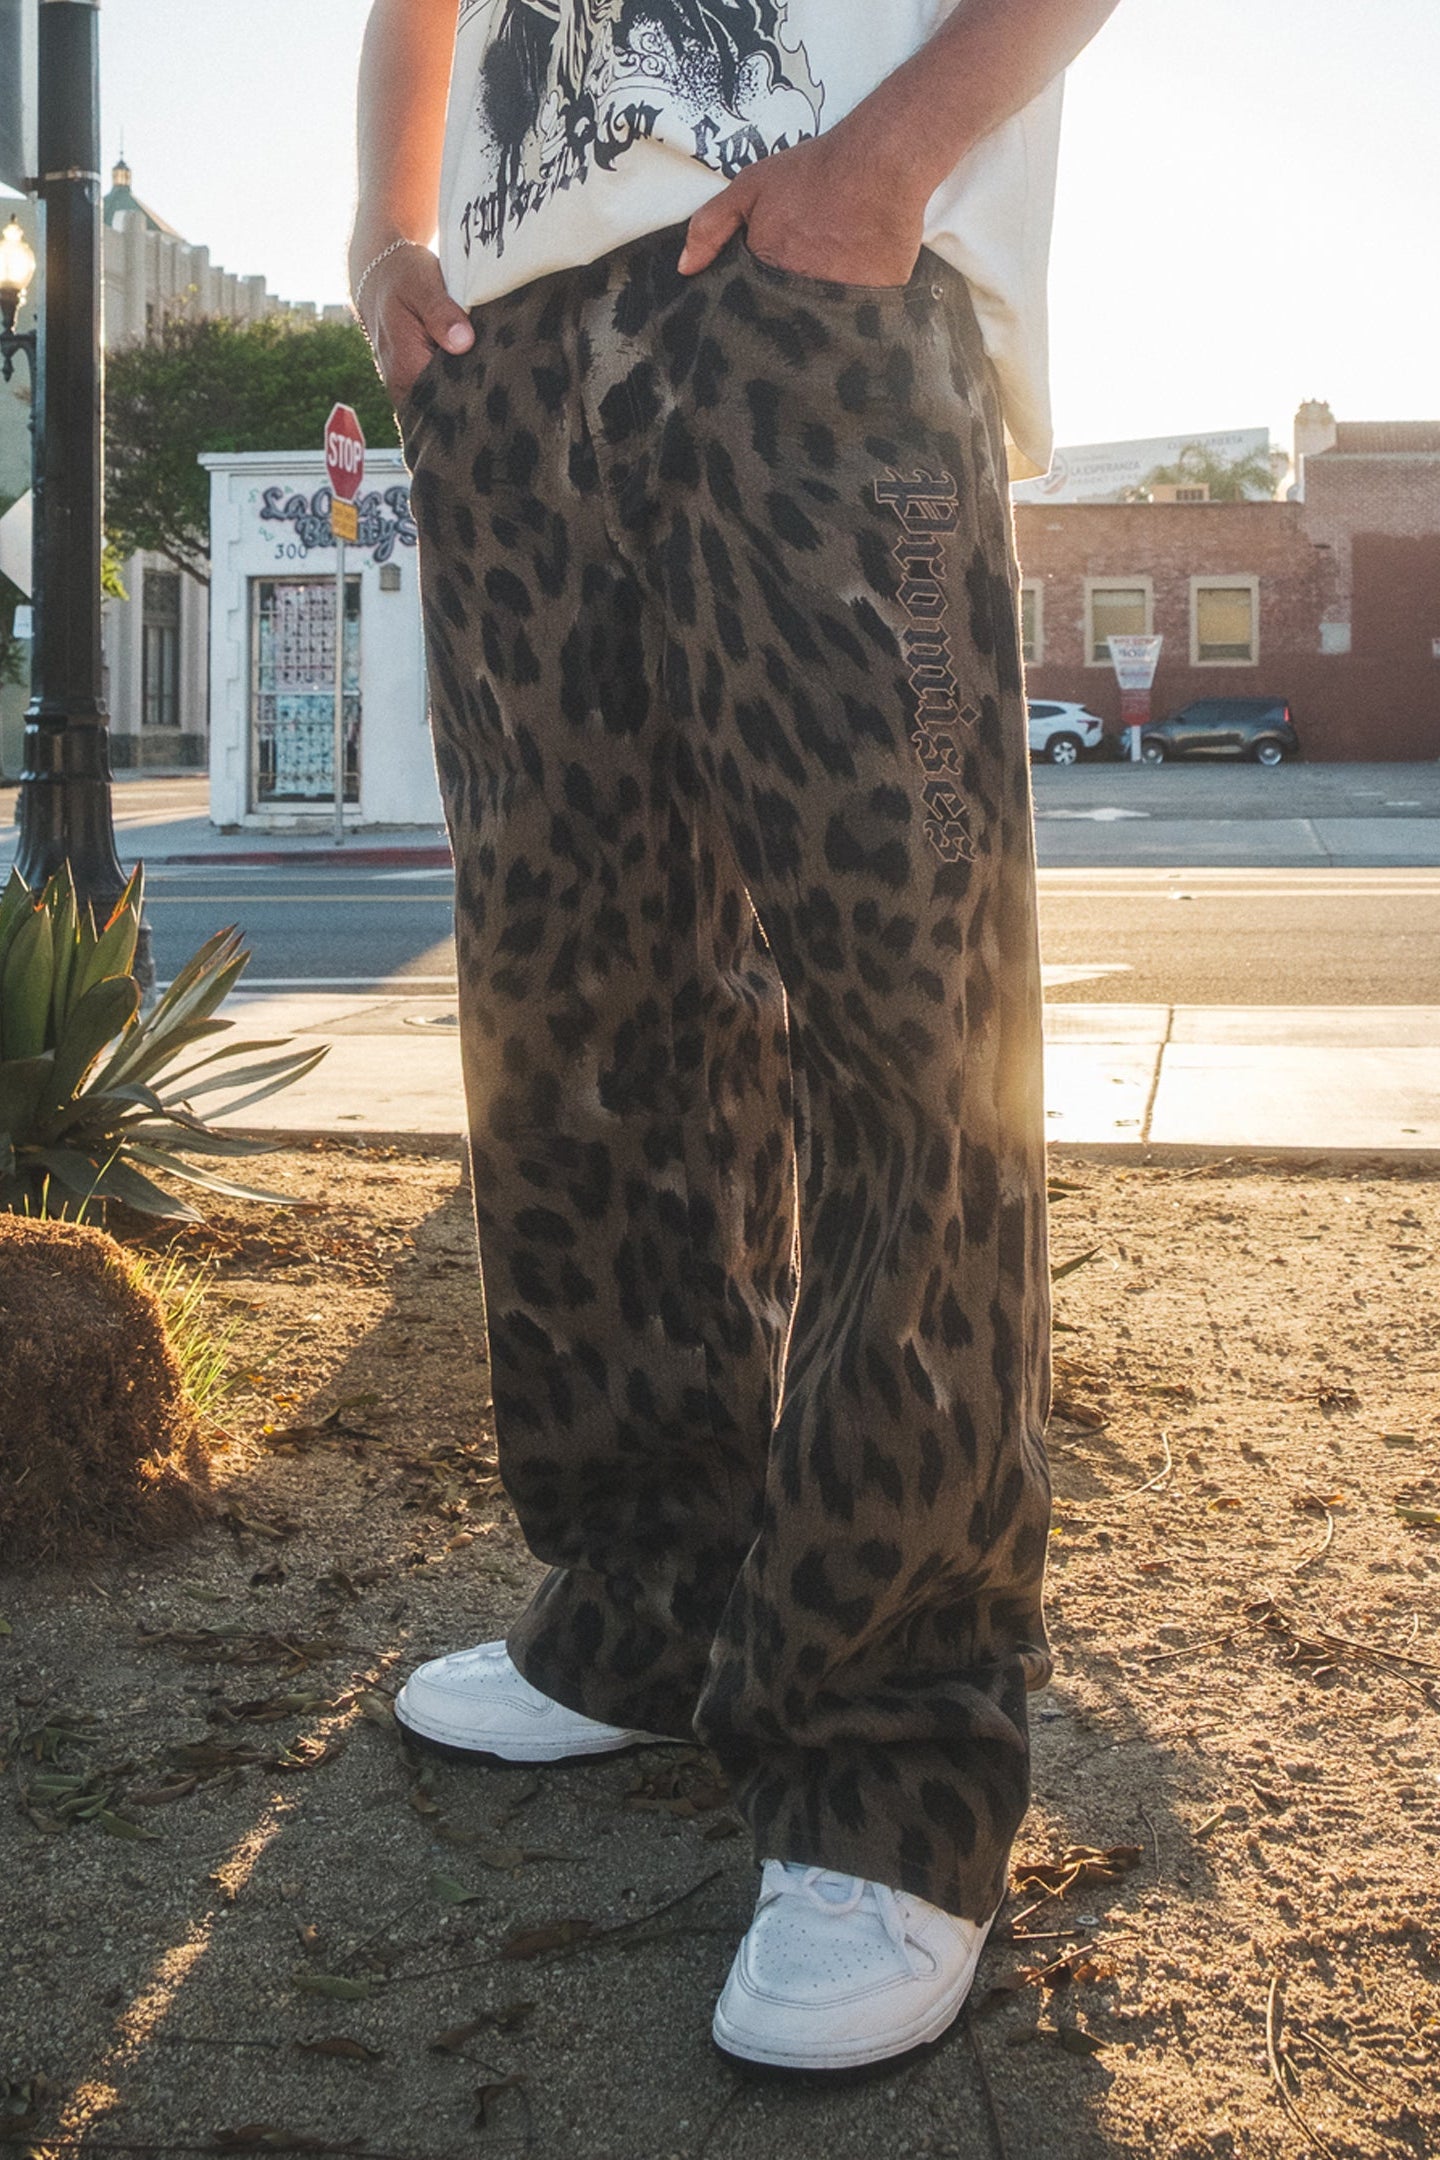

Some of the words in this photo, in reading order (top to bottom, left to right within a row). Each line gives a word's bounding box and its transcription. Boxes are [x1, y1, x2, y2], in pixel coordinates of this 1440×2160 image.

[328, 432, 362, 474] STOP
[260, 486, 308, 521] La
[274, 543, 309, 560] 300
[873, 466, 979, 863] Promises
